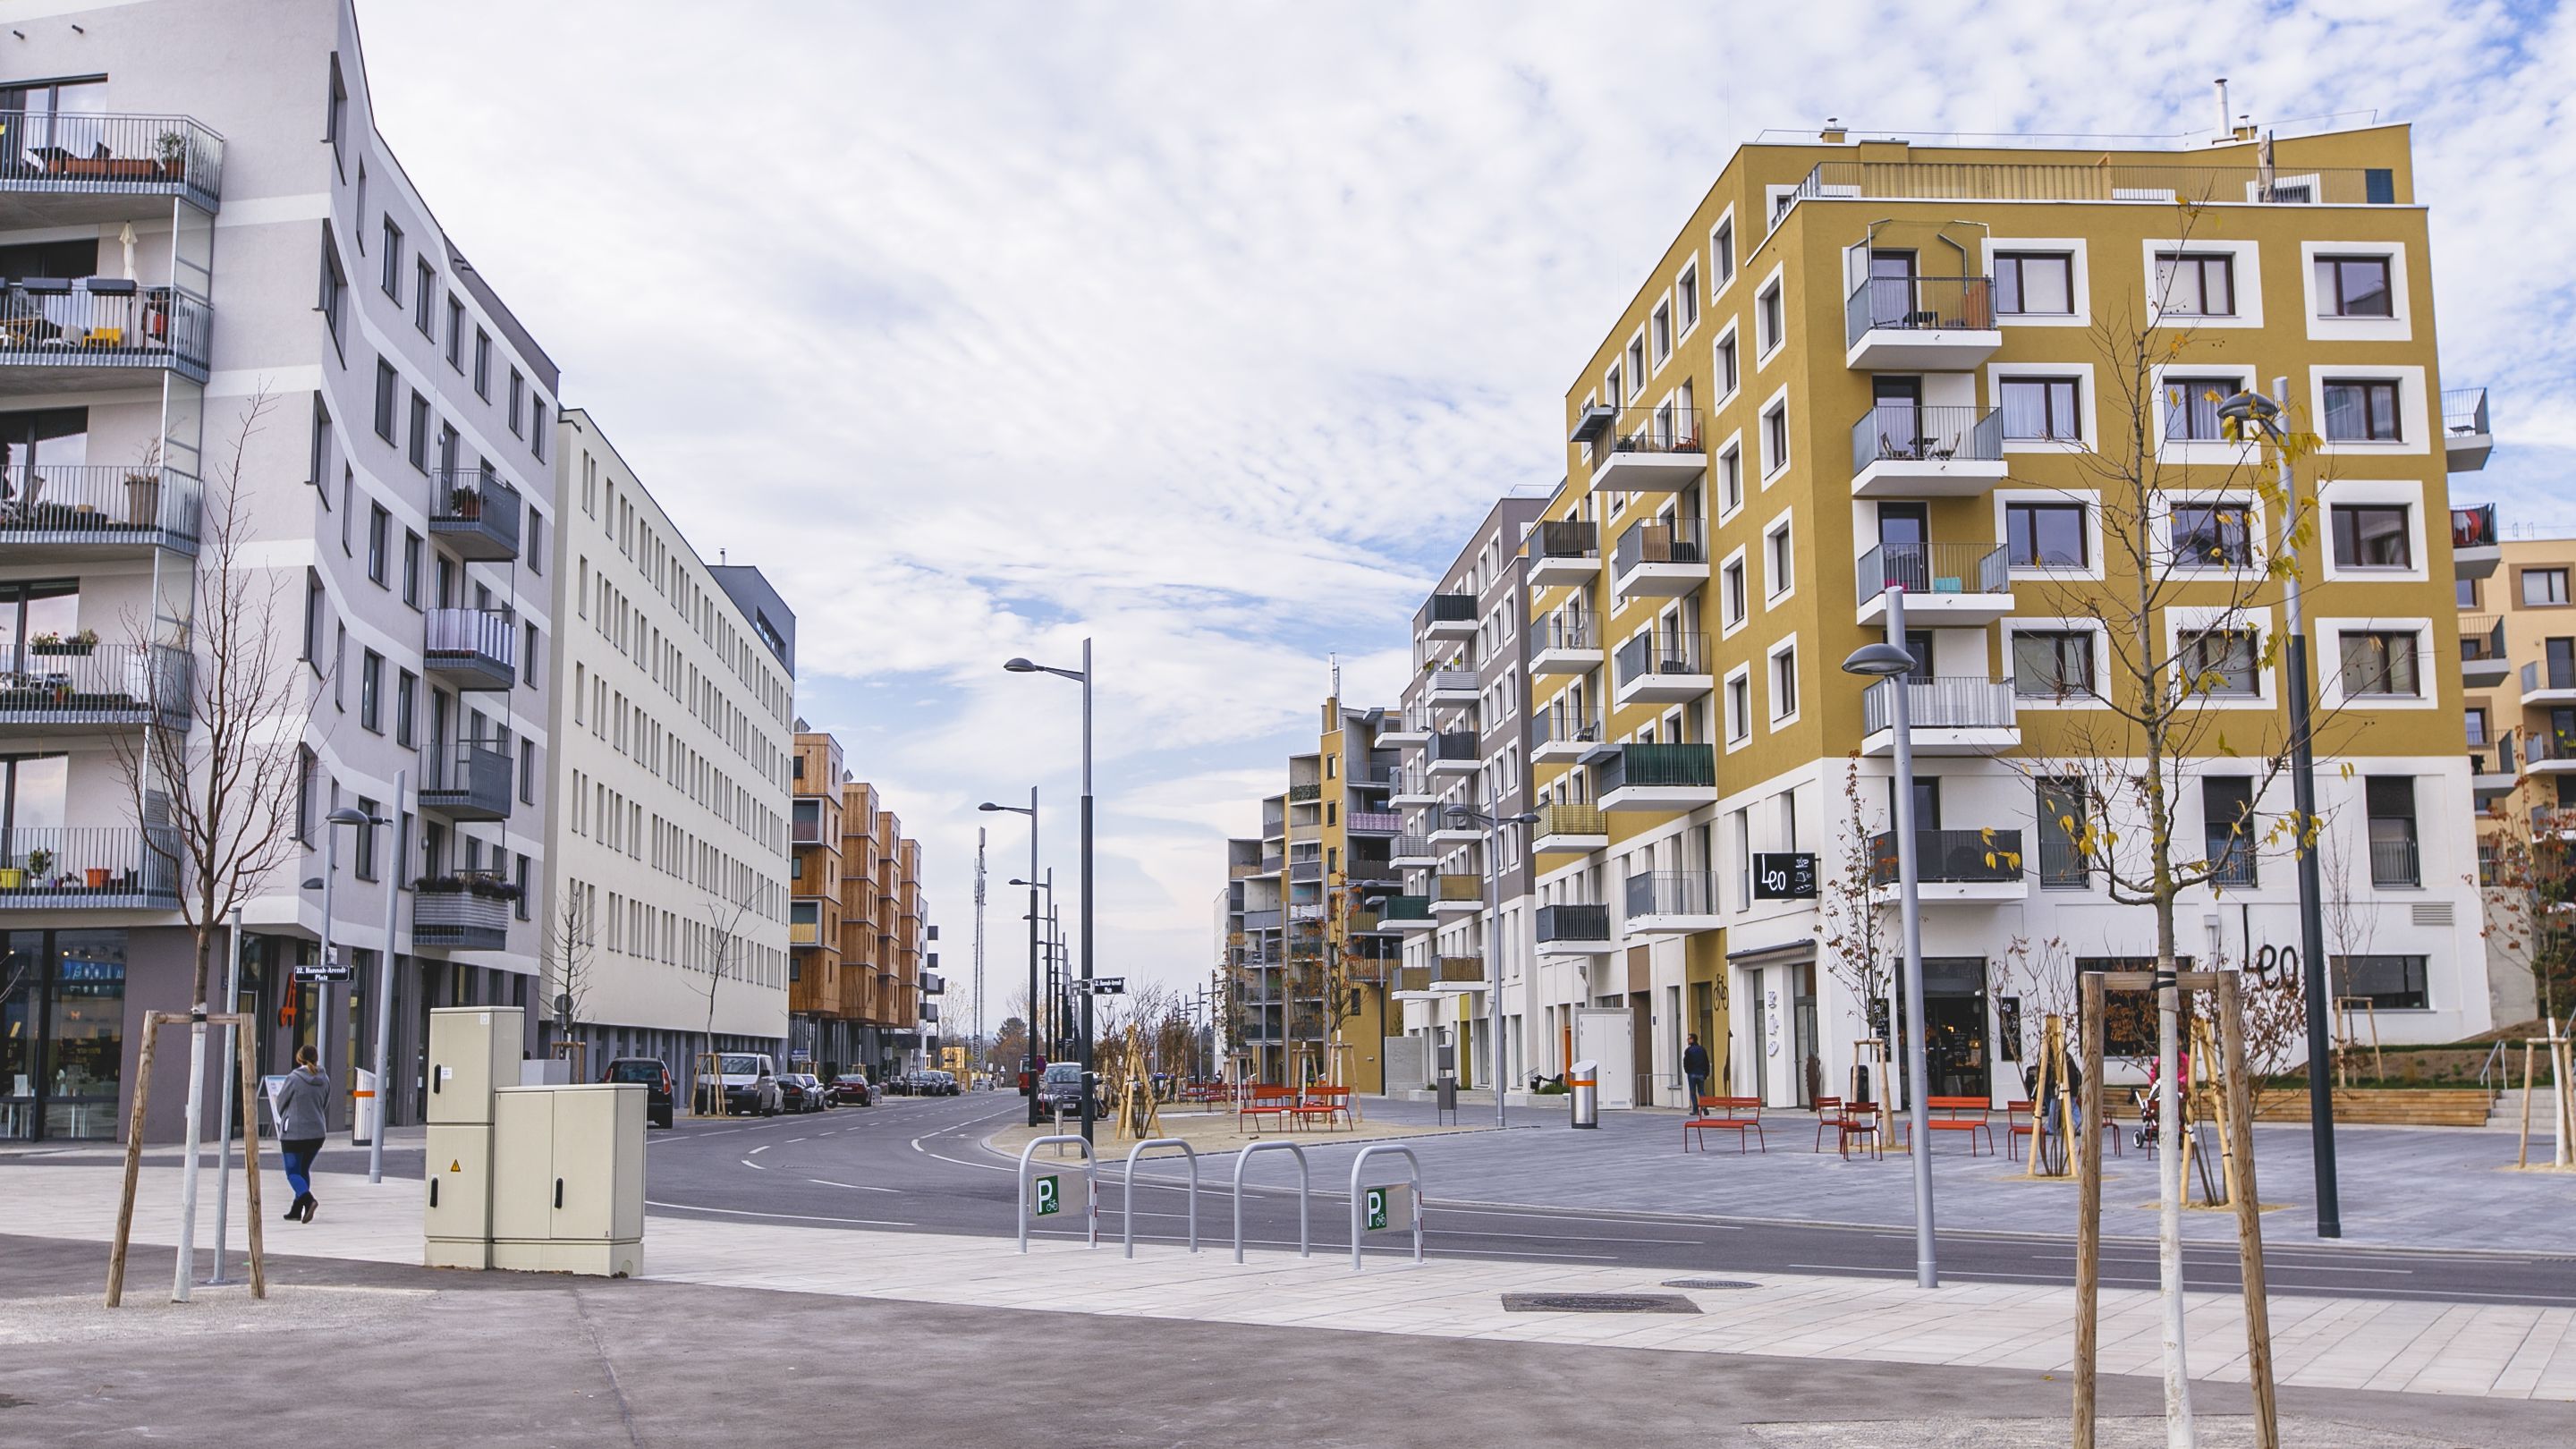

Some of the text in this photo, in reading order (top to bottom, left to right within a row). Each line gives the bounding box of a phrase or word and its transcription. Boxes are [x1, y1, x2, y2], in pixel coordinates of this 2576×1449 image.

[1761, 853, 1786, 891] Leo
[2241, 903, 2298, 990] Leo
[1038, 1180, 1053, 1213] P
[1368, 1191, 1381, 1227] P
